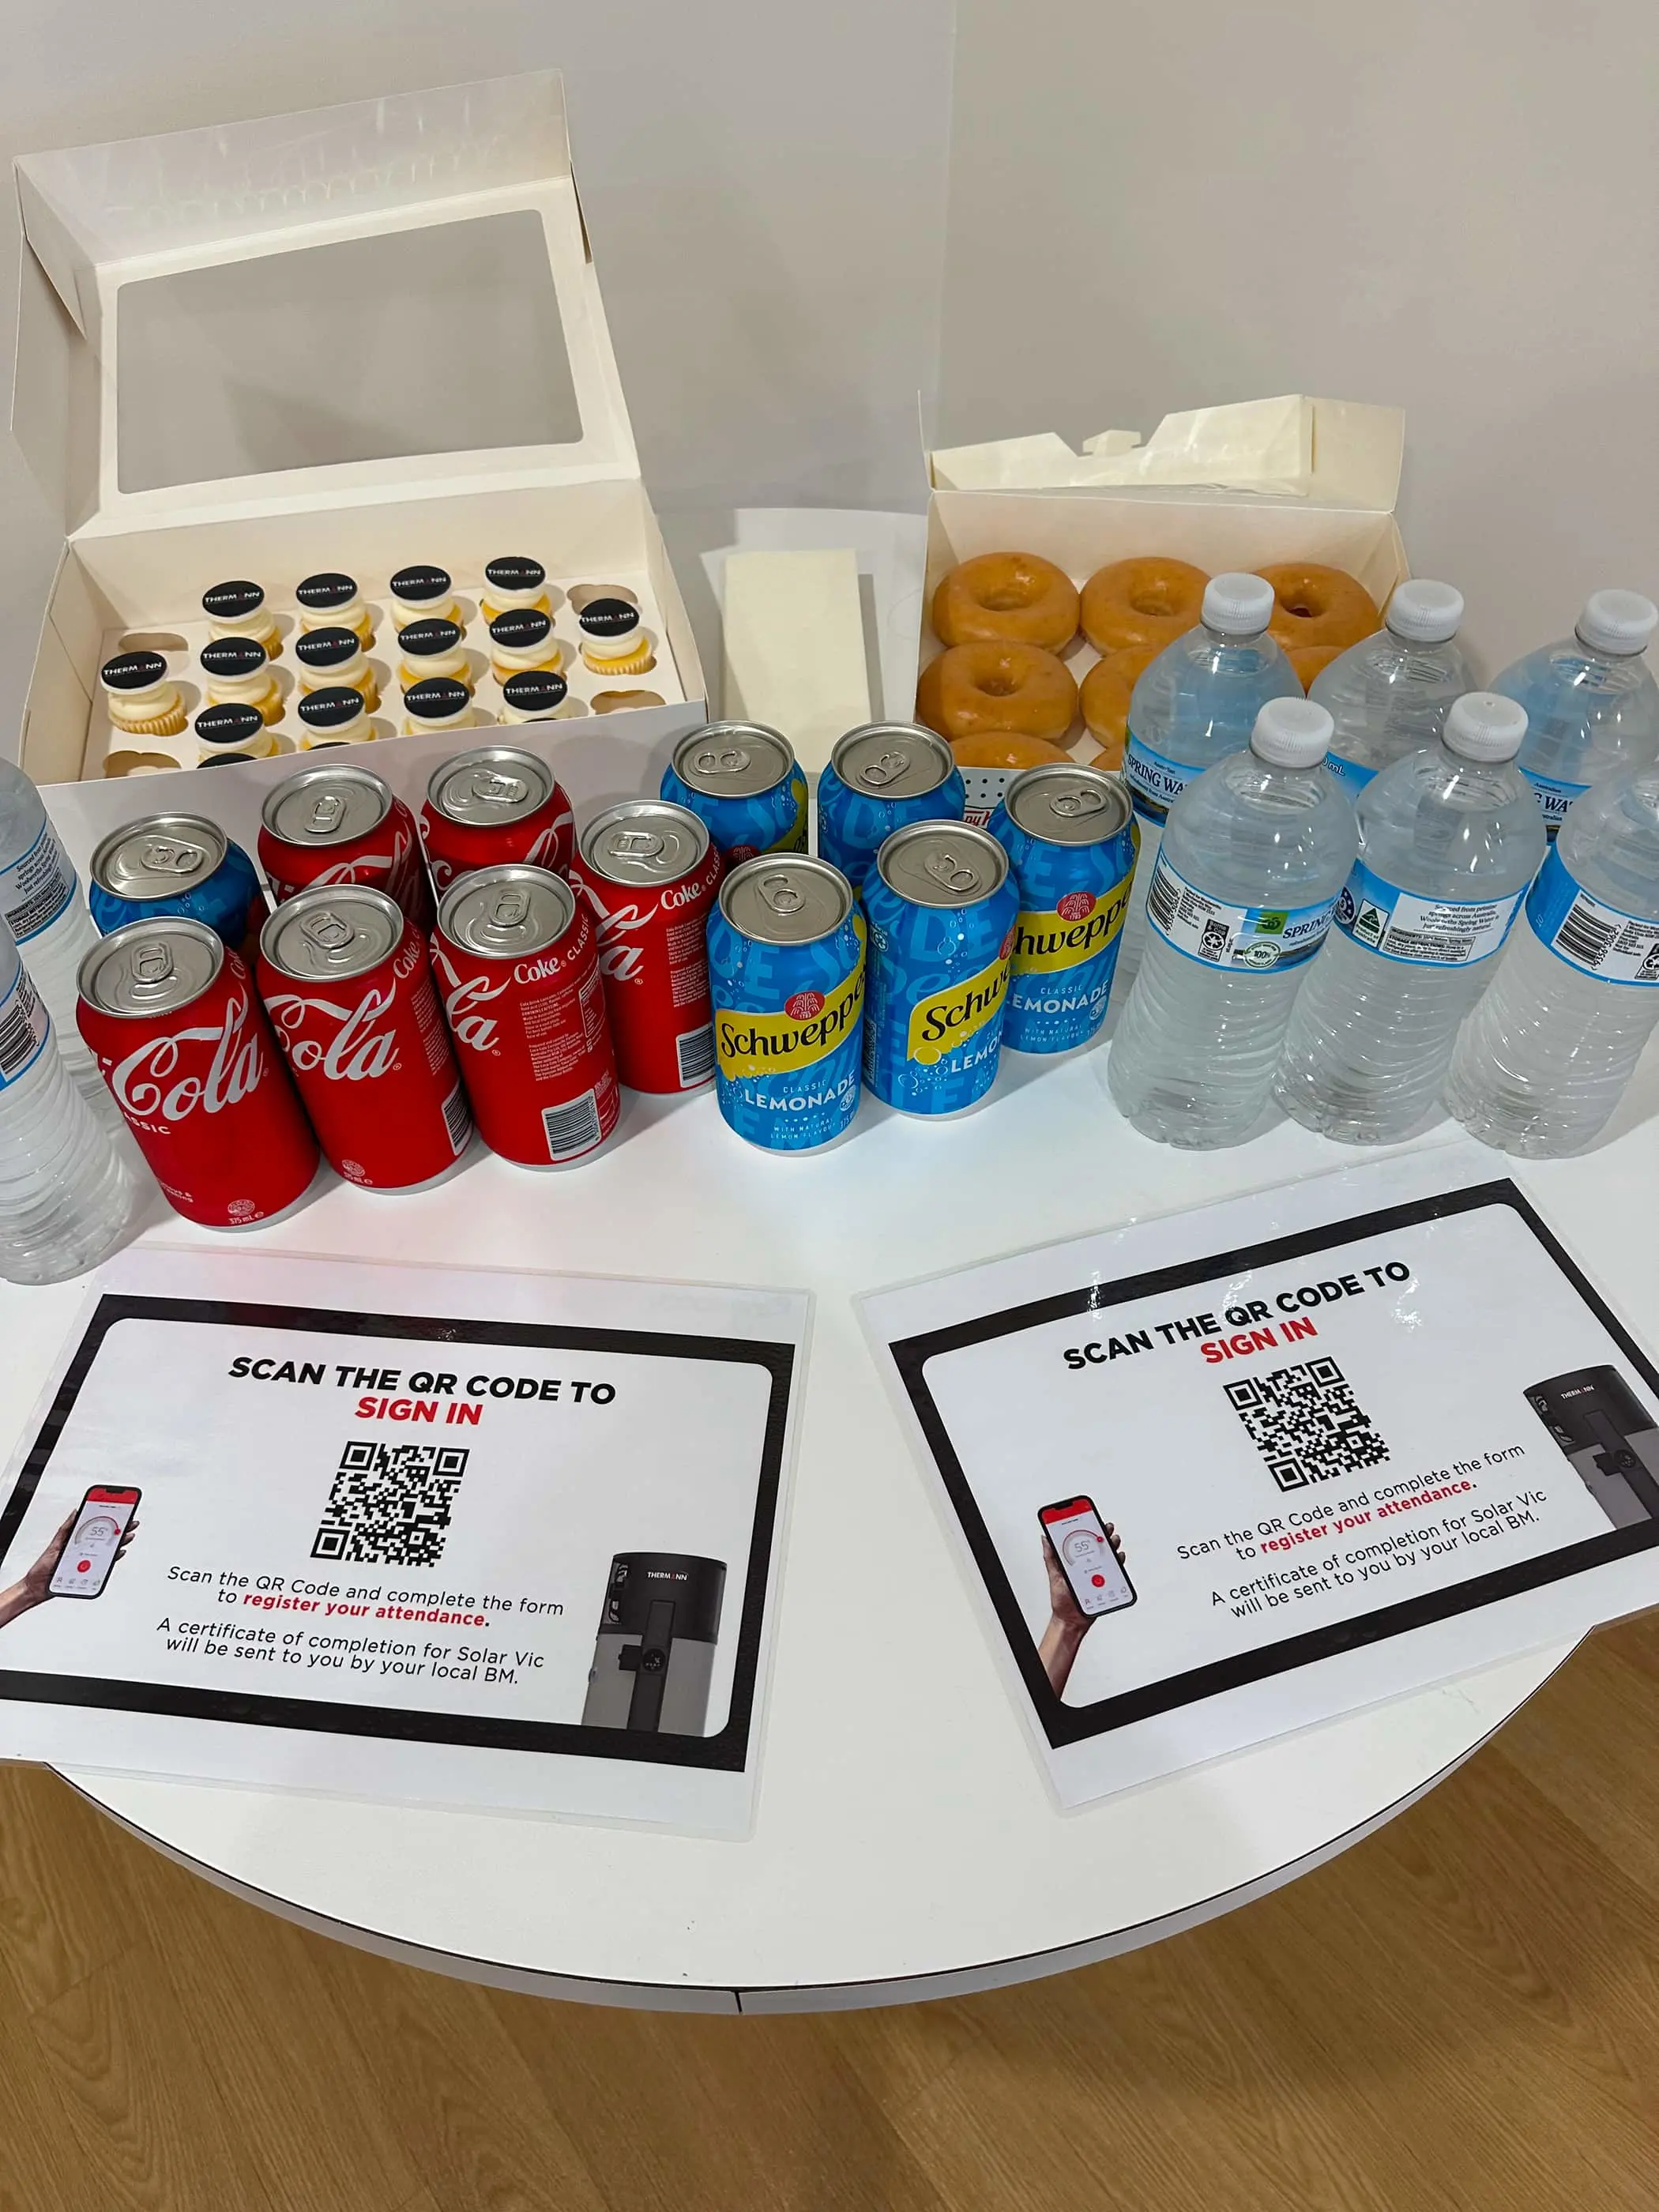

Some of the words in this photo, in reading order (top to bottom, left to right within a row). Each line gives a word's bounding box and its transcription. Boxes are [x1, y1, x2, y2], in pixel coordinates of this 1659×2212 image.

[1128, 754, 1161, 787] SPRING
[1329, 763, 1345, 776] mL
[661, 882, 702, 910] Coke
[393, 941, 421, 979] Coke
[514, 957, 561, 984] Coke
[566, 912, 591, 961] CLASSIC
[1593, 949, 1609, 967] 9356
[1604, 929, 1620, 948] 3062
[721, 971, 865, 1056] Schweppe
[1040, 984, 1082, 995] CLASSIC
[745, 1069, 855, 1111] LEMONADE
[784, 1080, 829, 1093] CLASSIC
[1063, 1330, 1155, 1370] SCAN
[1153, 1312, 1223, 1345] THE
[1224, 1300, 1274, 1327] QR
[1275, 1273, 1366, 1313] CODE
[1362, 1261, 1410, 1288] TO
[1200, 1326, 1279, 1364] SIGN
[1278, 1315, 1319, 1343] IN
[228, 1356, 327, 1386] SCAN
[335, 1365, 402, 1391] THE
[408, 1371, 458, 1395] QR
[465, 1375, 562, 1402] CODE
[570, 1381, 616, 1405] TO
[354, 1396, 440, 1423] SIGN
[445, 1402, 484, 1426] IN
[1176, 1539, 1221, 1559] Scan
[1223, 1529, 1254, 1546] the
[1257, 1518, 1286, 1536] QR
[1288, 1505, 1334, 1526] Code
[1337, 1491, 1371, 1512] and
[1374, 1469, 1451, 1501] complete
[1452, 1459, 1482, 1476] the
[1484, 1446, 1525, 1466] form
[1236, 1547, 1256, 1560] to
[1260, 1524, 1328, 1554] register
[1331, 1510, 1372, 1534] your
[1376, 1480, 1477, 1518] attendance.
[1212, 1591, 1226, 1607] A
[1229, 1564, 1319, 1600] certificate
[1322, 1554, 1341, 1571] of
[1345, 1526, 1441, 1564] completion
[1441, 1516, 1467, 1533] for
[1470, 1500, 1514, 1523] Solar
[1515, 1491, 1548, 1507] Vic
[1230, 1597, 1263, 1618] will
[1264, 1592, 1290, 1608] be
[1293, 1577, 1333, 1599] sent
[1334, 1572, 1354, 1586] to
[1356, 1559, 1392, 1582] you
[1392, 1551, 1416, 1567] by
[1419, 1537, 1458, 1561] your
[1461, 1519, 1505, 1545] local
[1504, 1510, 1540, 1529] BM.
[167, 1566, 213, 1584] Scan
[219, 1571, 250, 1588] the
[255, 1575, 285, 1592] QR
[291, 1579, 340, 1597] Code
[345, 1586, 382, 1601] and
[386, 1590, 476, 1608] complete
[482, 1594, 513, 1612] the
[519, 1597, 564, 1616] form
[217, 1588, 238, 1604] to
[243, 1593, 321, 1612] register
[324, 1602, 371, 1617] your
[374, 1605, 491, 1627] attendance.
[156, 1617, 171, 1632] A
[178, 1622, 276, 1643] certificate
[282, 1631, 305, 1646] of
[308, 1636, 416, 1657] completion
[423, 1642, 452, 1660] for
[457, 1646, 508, 1665] Solar
[515, 1650, 544, 1668] Vic
[167, 1636, 200, 1653] will
[203, 1638, 228, 1657] be
[233, 1646, 276, 1661] sent
[282, 1648, 303, 1664] to
[307, 1653, 344, 1668] you
[350, 1653, 375, 1673] by
[379, 1660, 427, 1676] your
[431, 1661, 479, 1681] local
[483, 1666, 518, 1685] BM.
